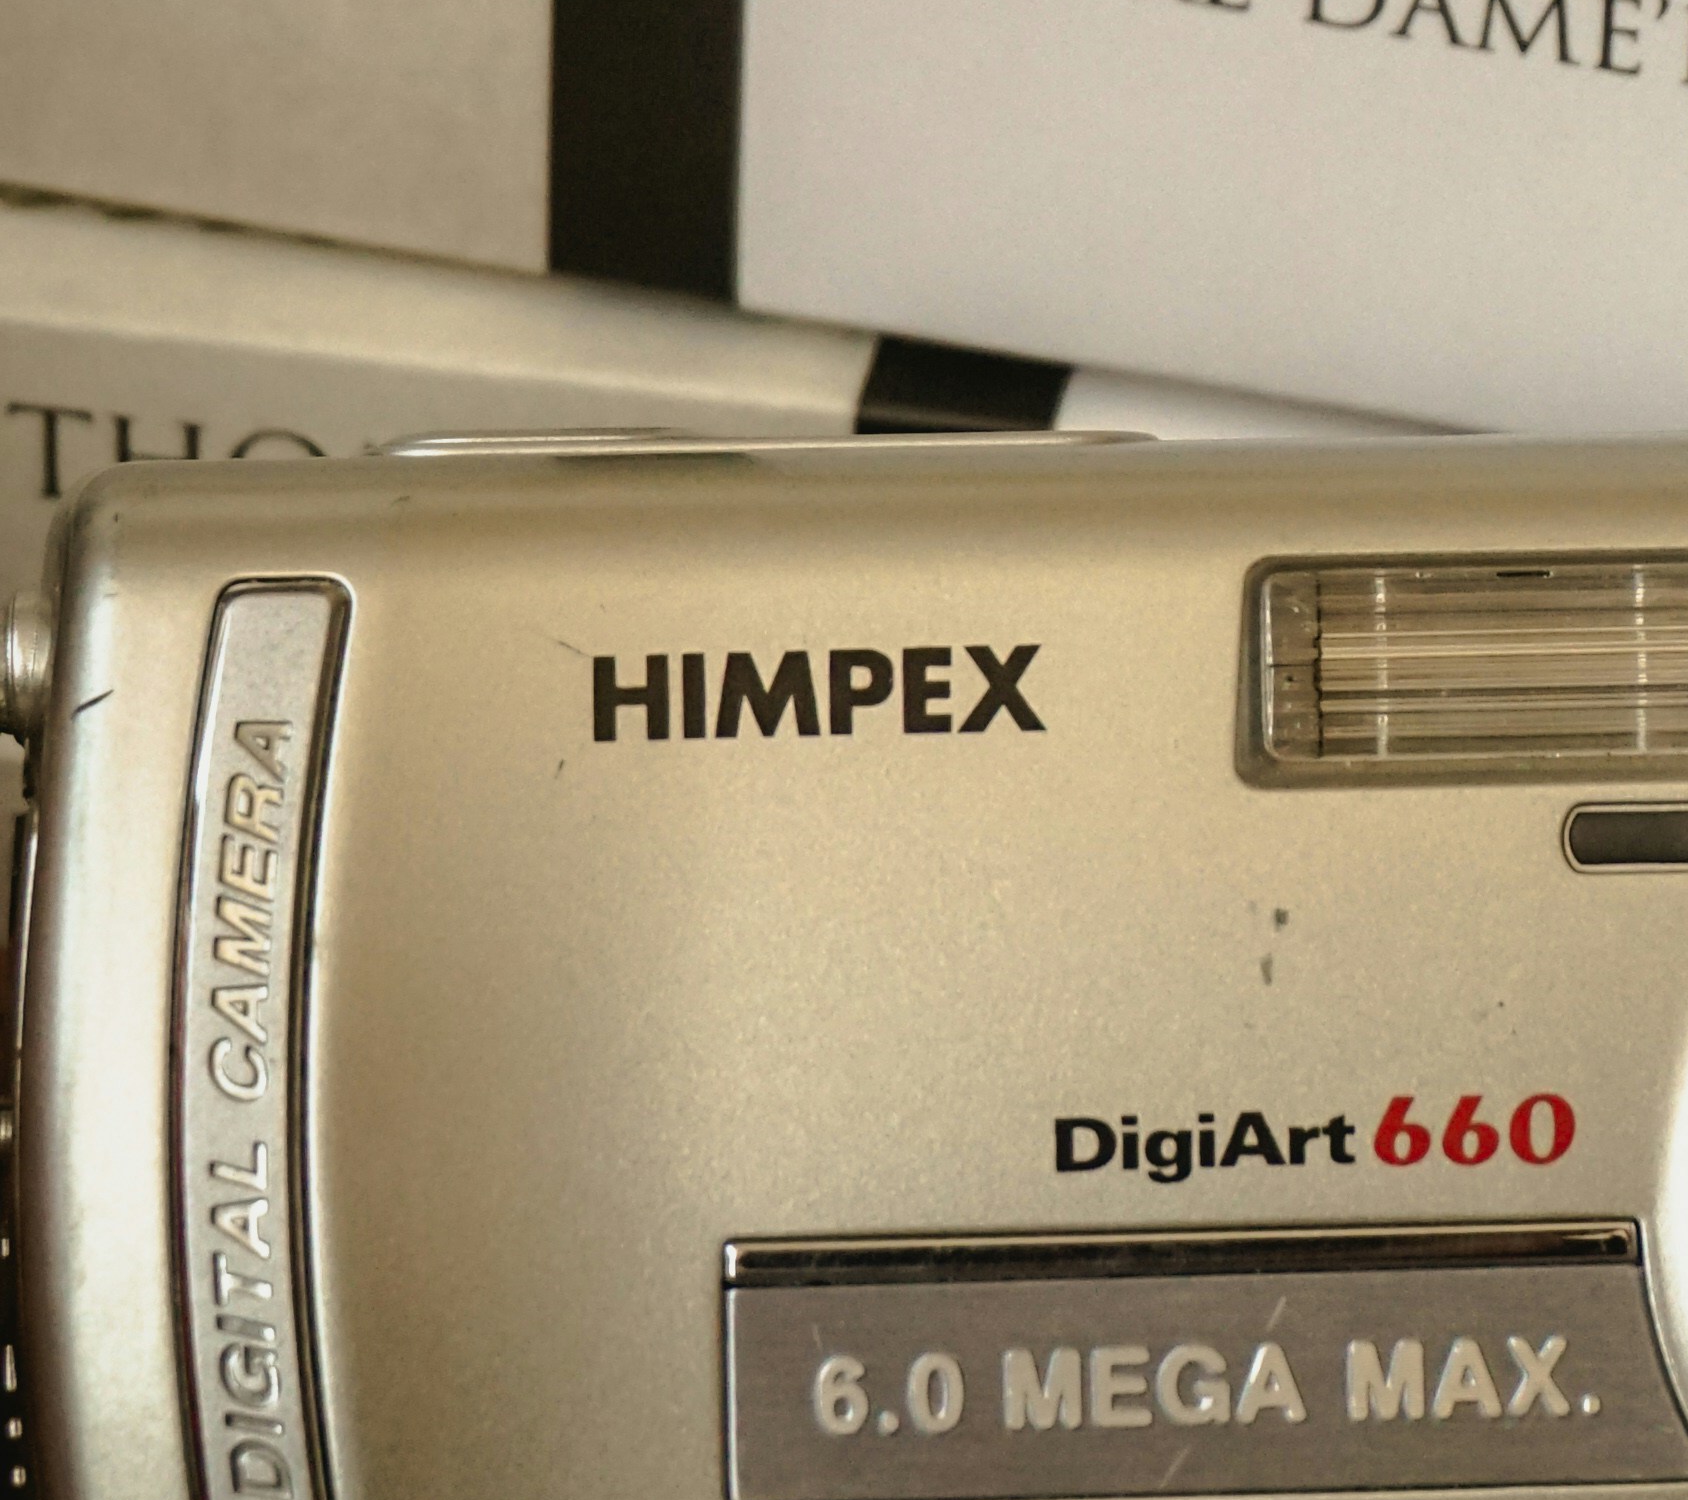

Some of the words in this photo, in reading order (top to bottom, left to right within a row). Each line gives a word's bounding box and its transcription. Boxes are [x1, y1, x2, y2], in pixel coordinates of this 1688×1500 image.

[593, 643, 1046, 742] HIMPEX
[208, 718, 294, 1103] CAMERA
[811, 1352, 966, 1436] 6.0
[1002, 1342, 1308, 1430] MEGA
[1345, 1334, 1602, 1422] MAX.
